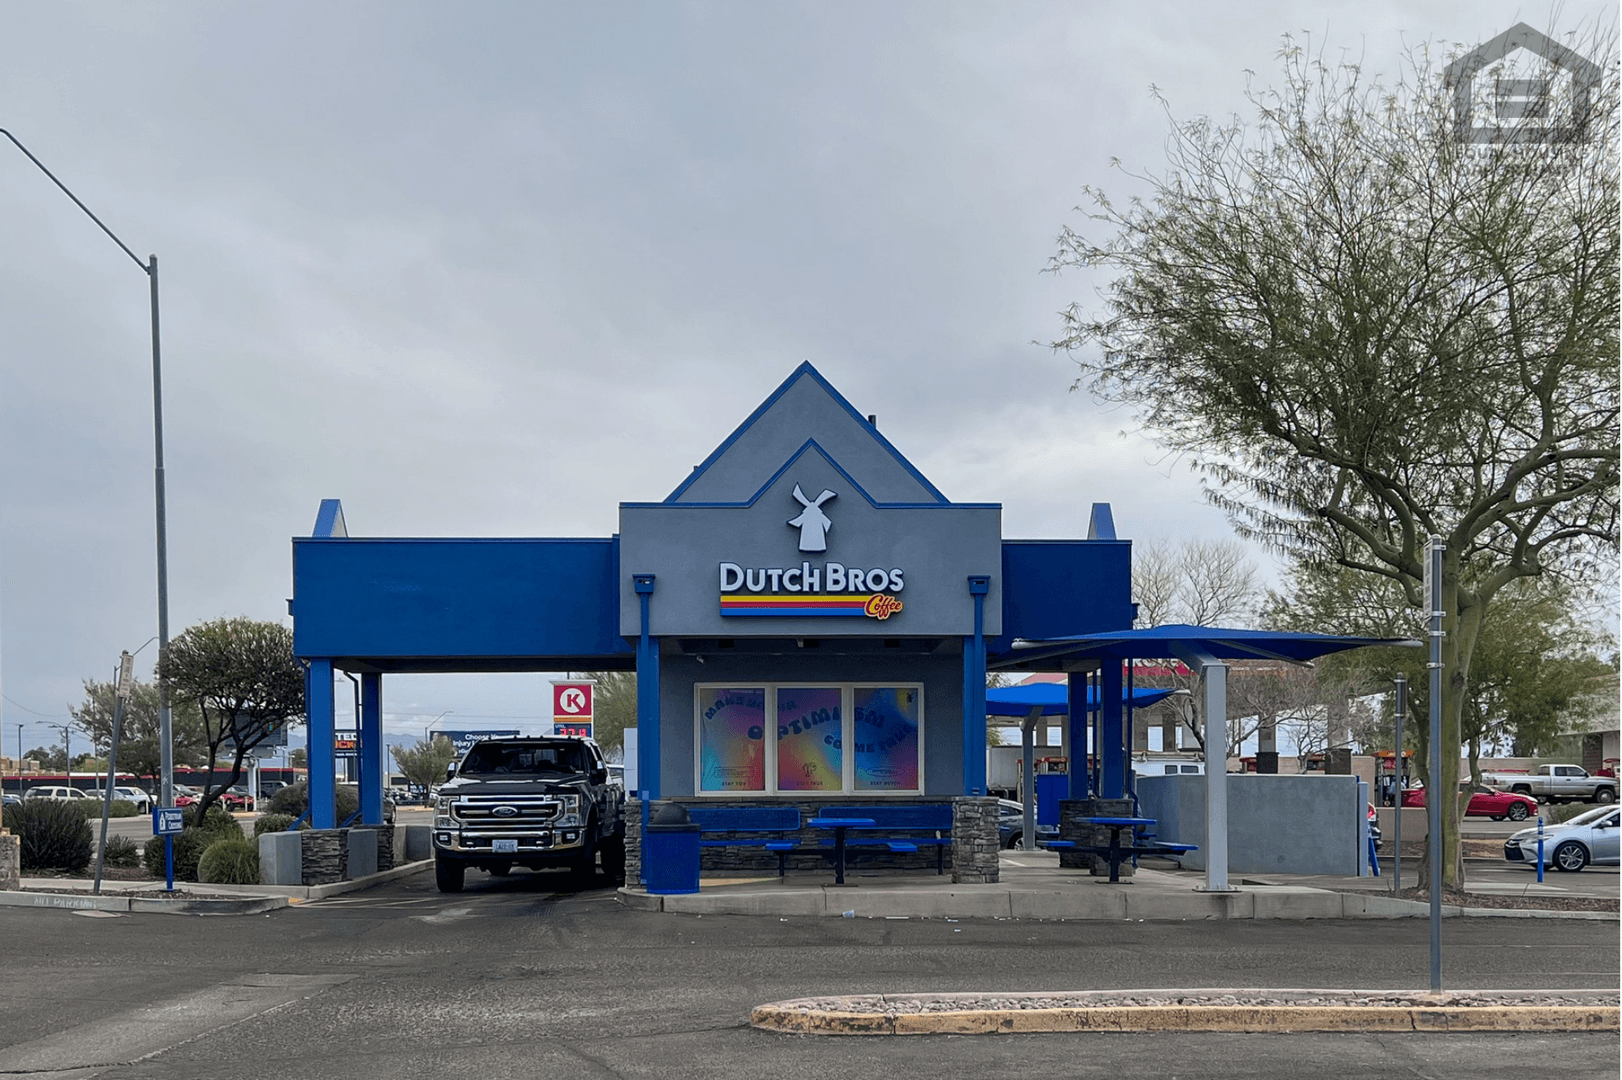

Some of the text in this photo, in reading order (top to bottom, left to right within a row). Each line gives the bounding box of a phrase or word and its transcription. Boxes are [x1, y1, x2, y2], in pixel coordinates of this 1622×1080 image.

[719, 561, 905, 592] DUTCH BROS
[865, 593, 902, 619] Coffee
[747, 706, 885, 741] OPTIMISM
[465, 733, 490, 741] Choose
[823, 735, 875, 753] COME
[34, 896, 97, 909] NO PARKING
